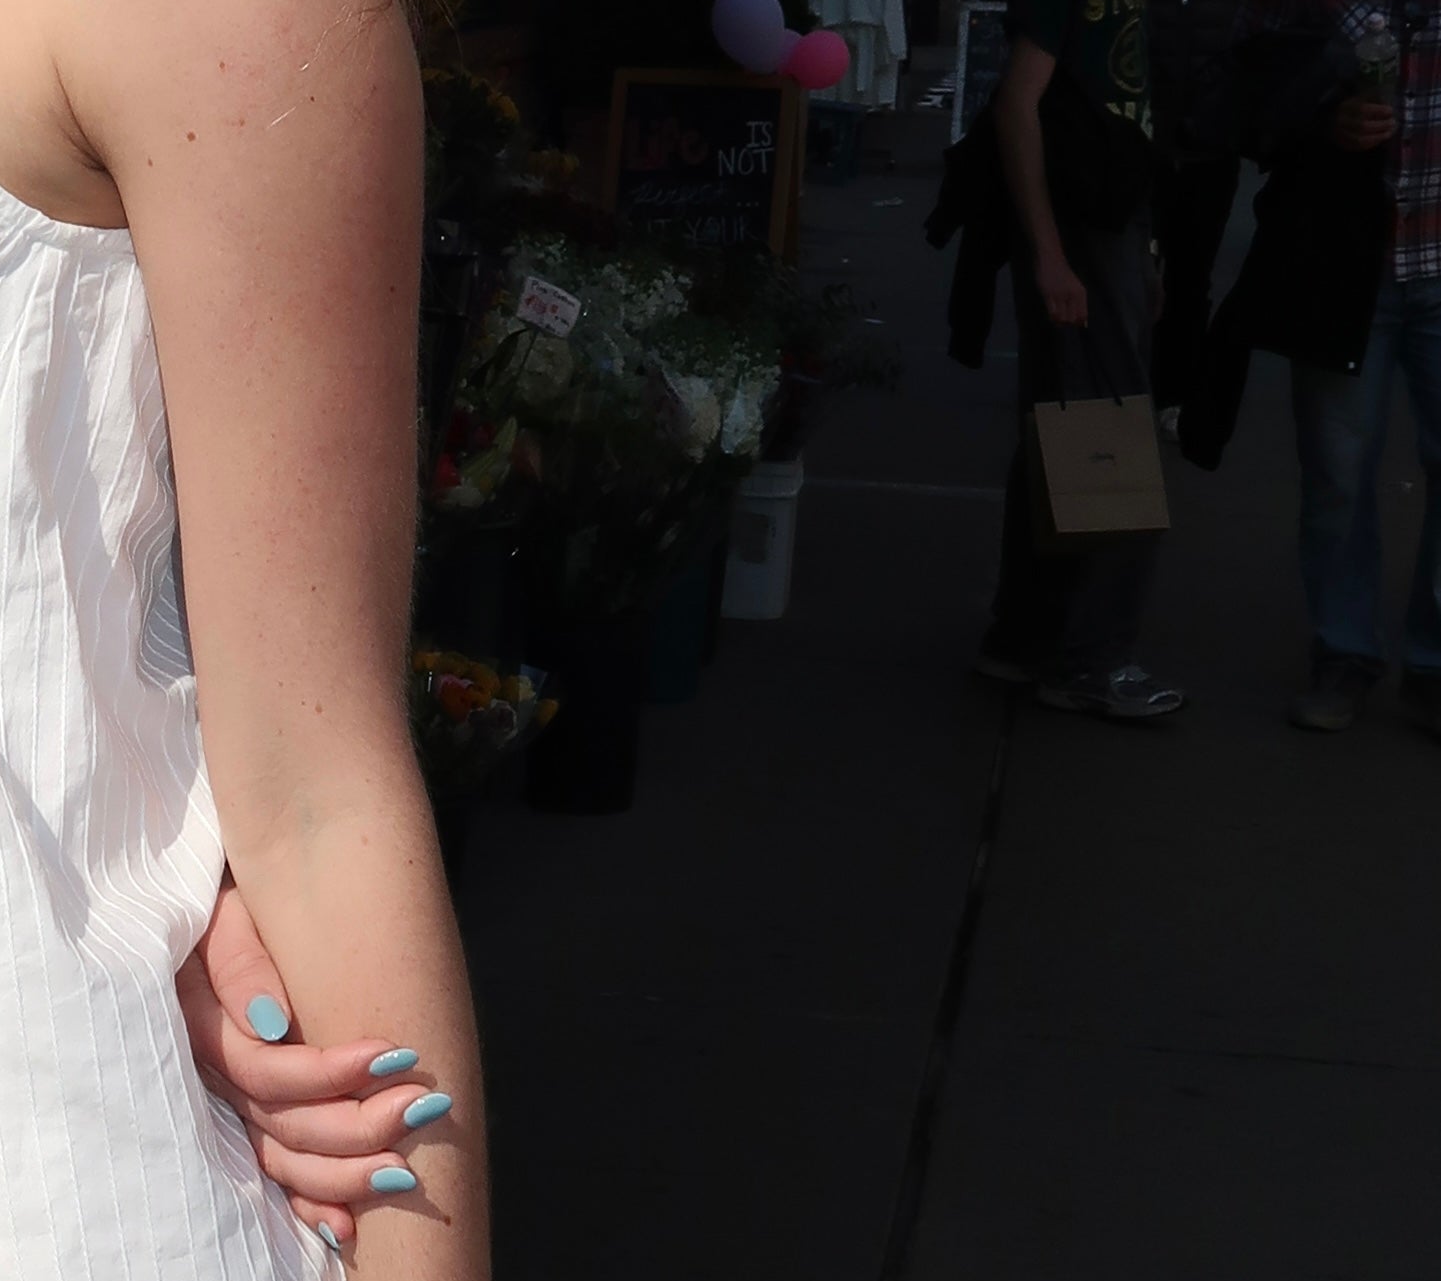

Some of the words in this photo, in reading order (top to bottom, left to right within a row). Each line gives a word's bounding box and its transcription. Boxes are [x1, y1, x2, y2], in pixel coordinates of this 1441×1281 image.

[745, 120, 774, 147] IS
[717, 146, 775, 176] NOT
[683, 214, 759, 247] YOUR
